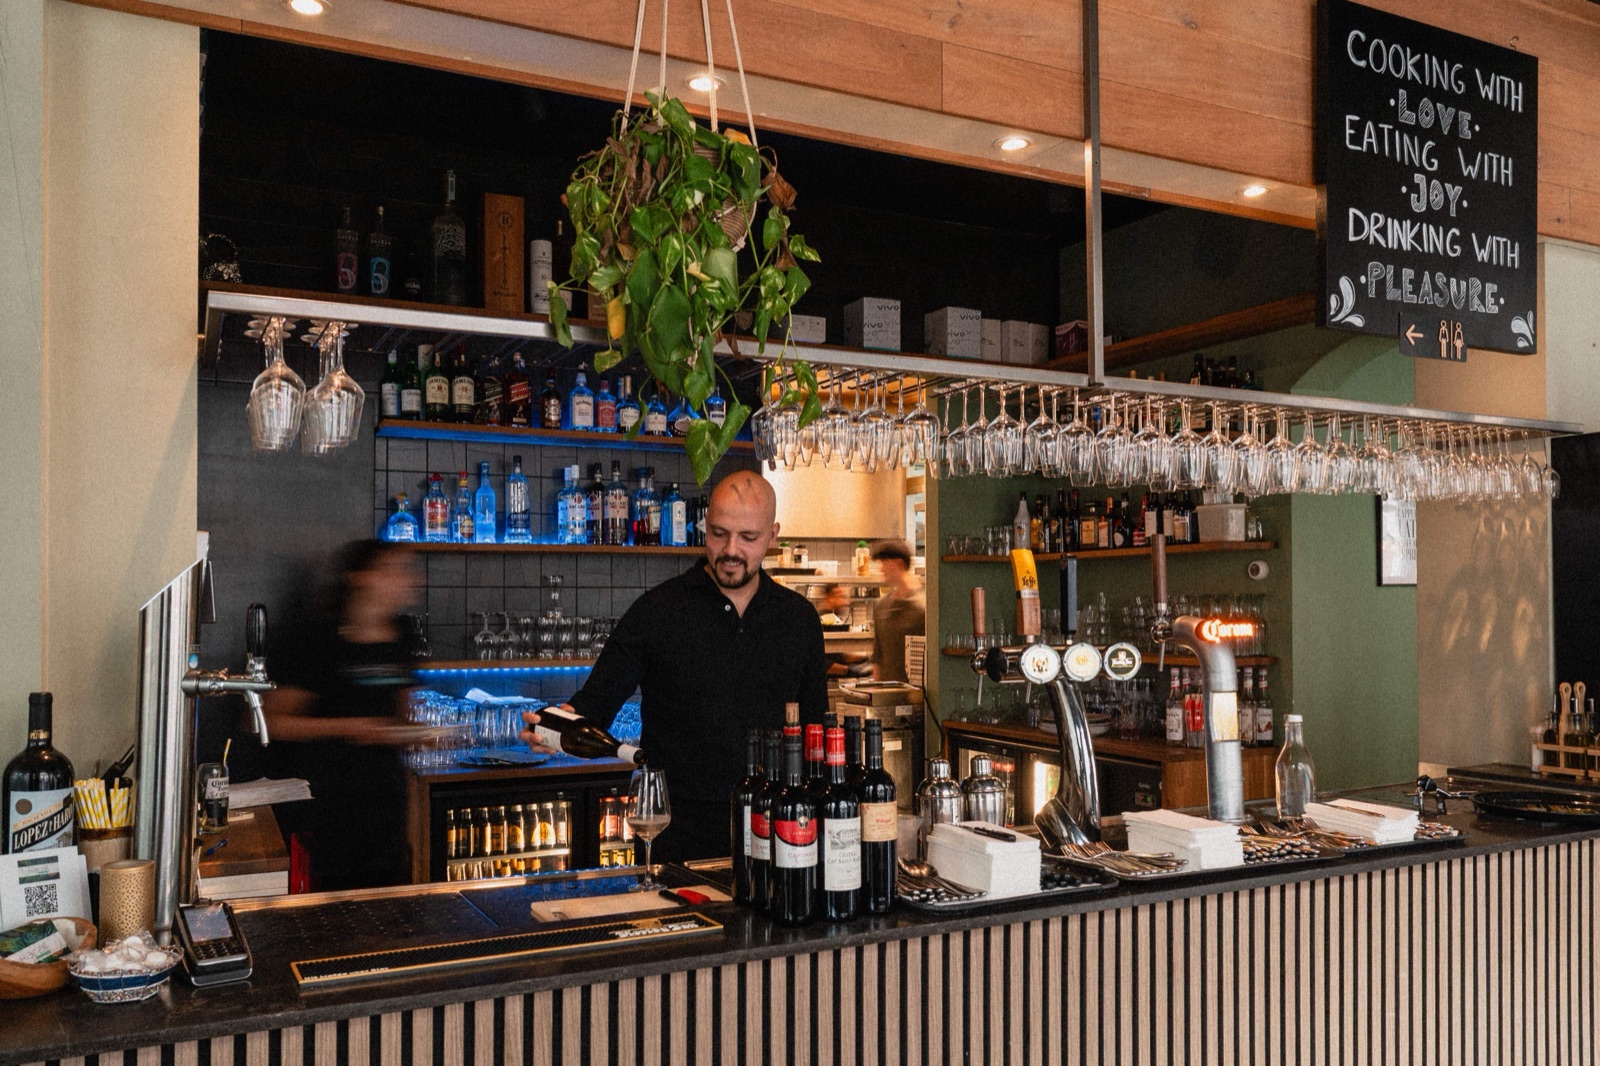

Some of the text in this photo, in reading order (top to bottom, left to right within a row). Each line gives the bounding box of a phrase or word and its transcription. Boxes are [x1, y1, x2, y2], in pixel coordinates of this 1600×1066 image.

[1347, 30, 1524, 113] COOKING WITH
[1398, 88, 1472, 140] LOVE
[1346, 114, 1513, 187] EATING WITH
[1410, 173, 1463, 217] JOY
[1348, 207, 1520, 269] DRINKING WITH
[1367, 261, 1499, 314] PLEASURE
[960, 313, 981, 321] vivo
[14, 820, 49, 849] LOPEZ
